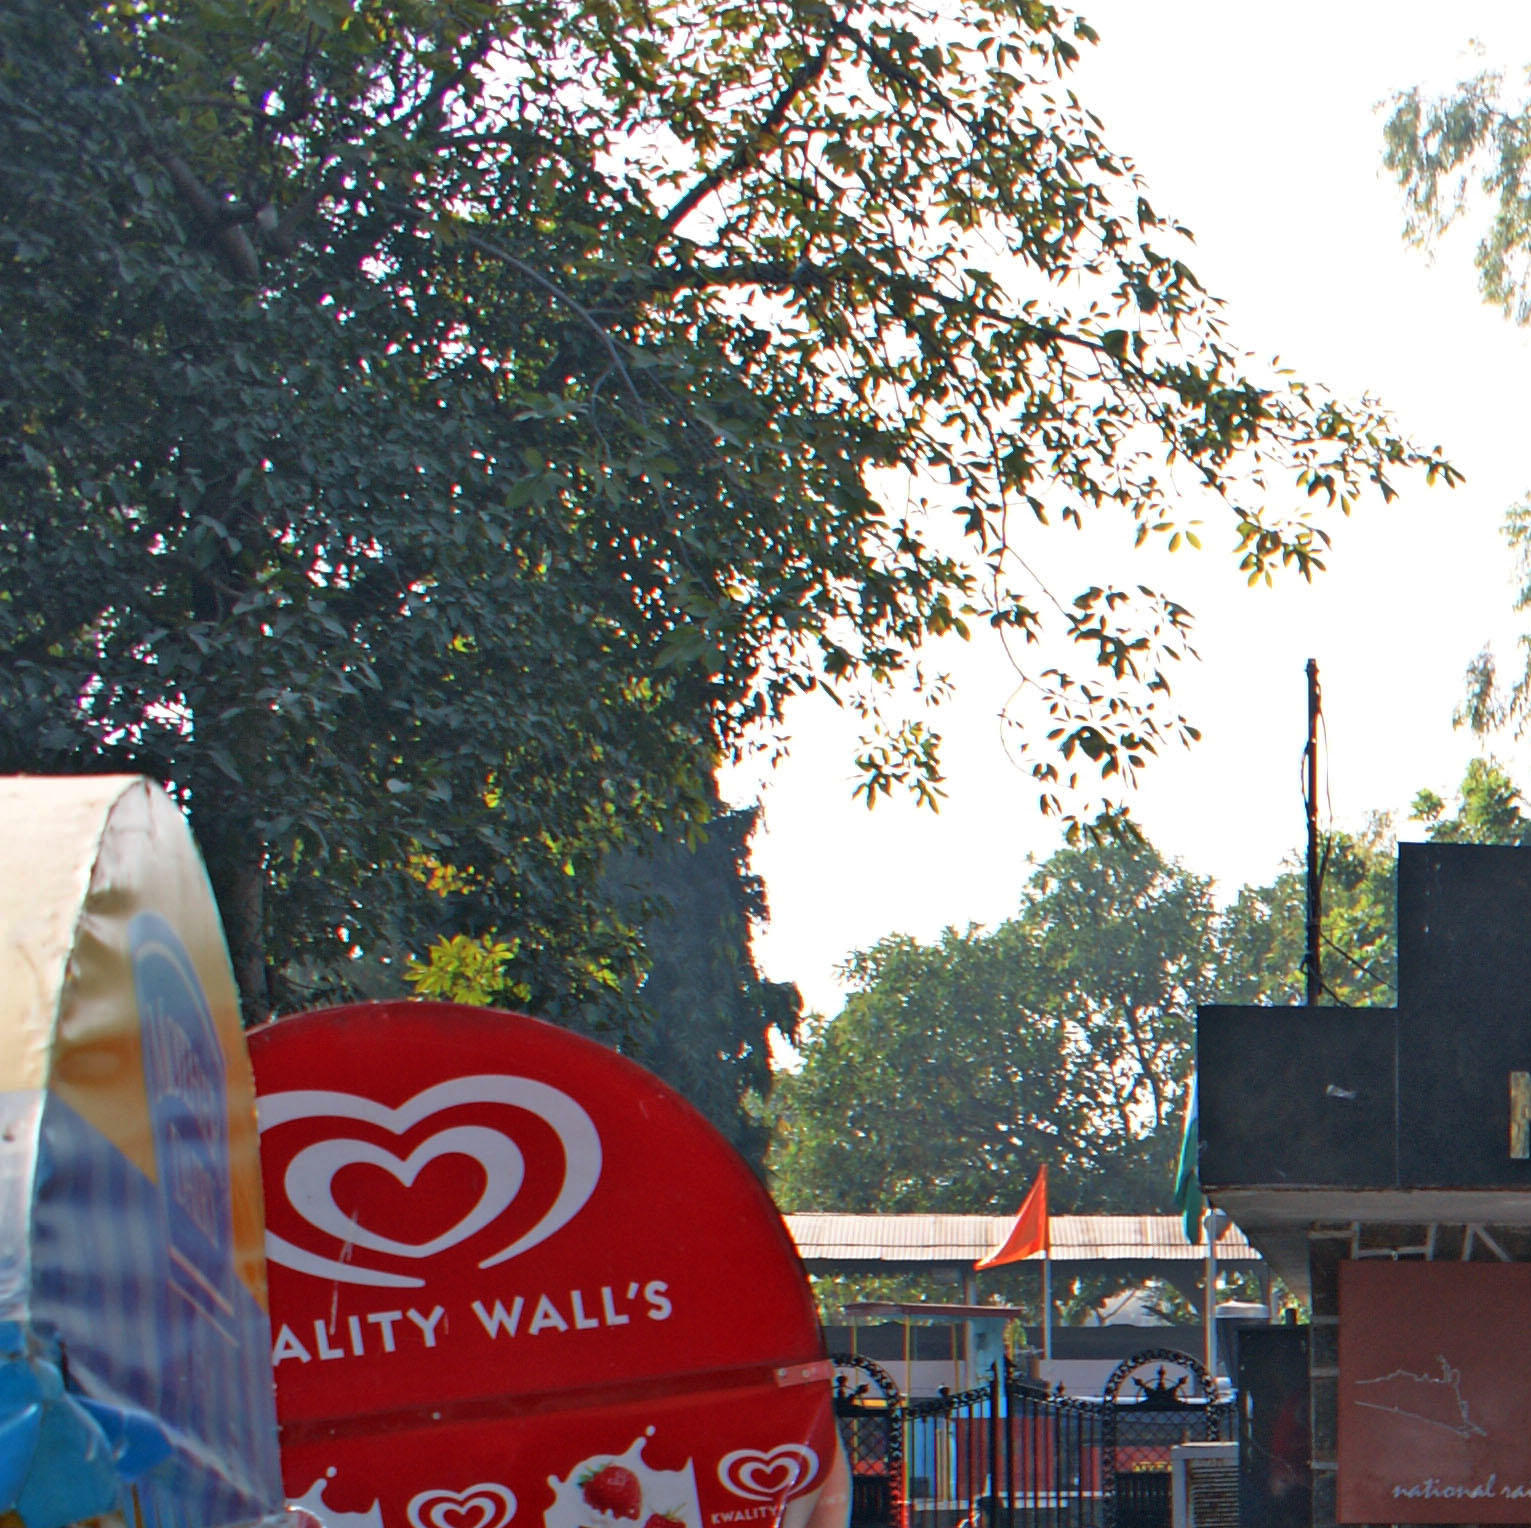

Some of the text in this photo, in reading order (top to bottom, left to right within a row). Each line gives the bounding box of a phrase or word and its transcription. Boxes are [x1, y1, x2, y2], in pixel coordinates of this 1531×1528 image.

[471, 1280, 673, 1339] WALL'S
[1392, 1473, 1497, 1499] national
[711, 1505, 777, 1525] KWALITY
